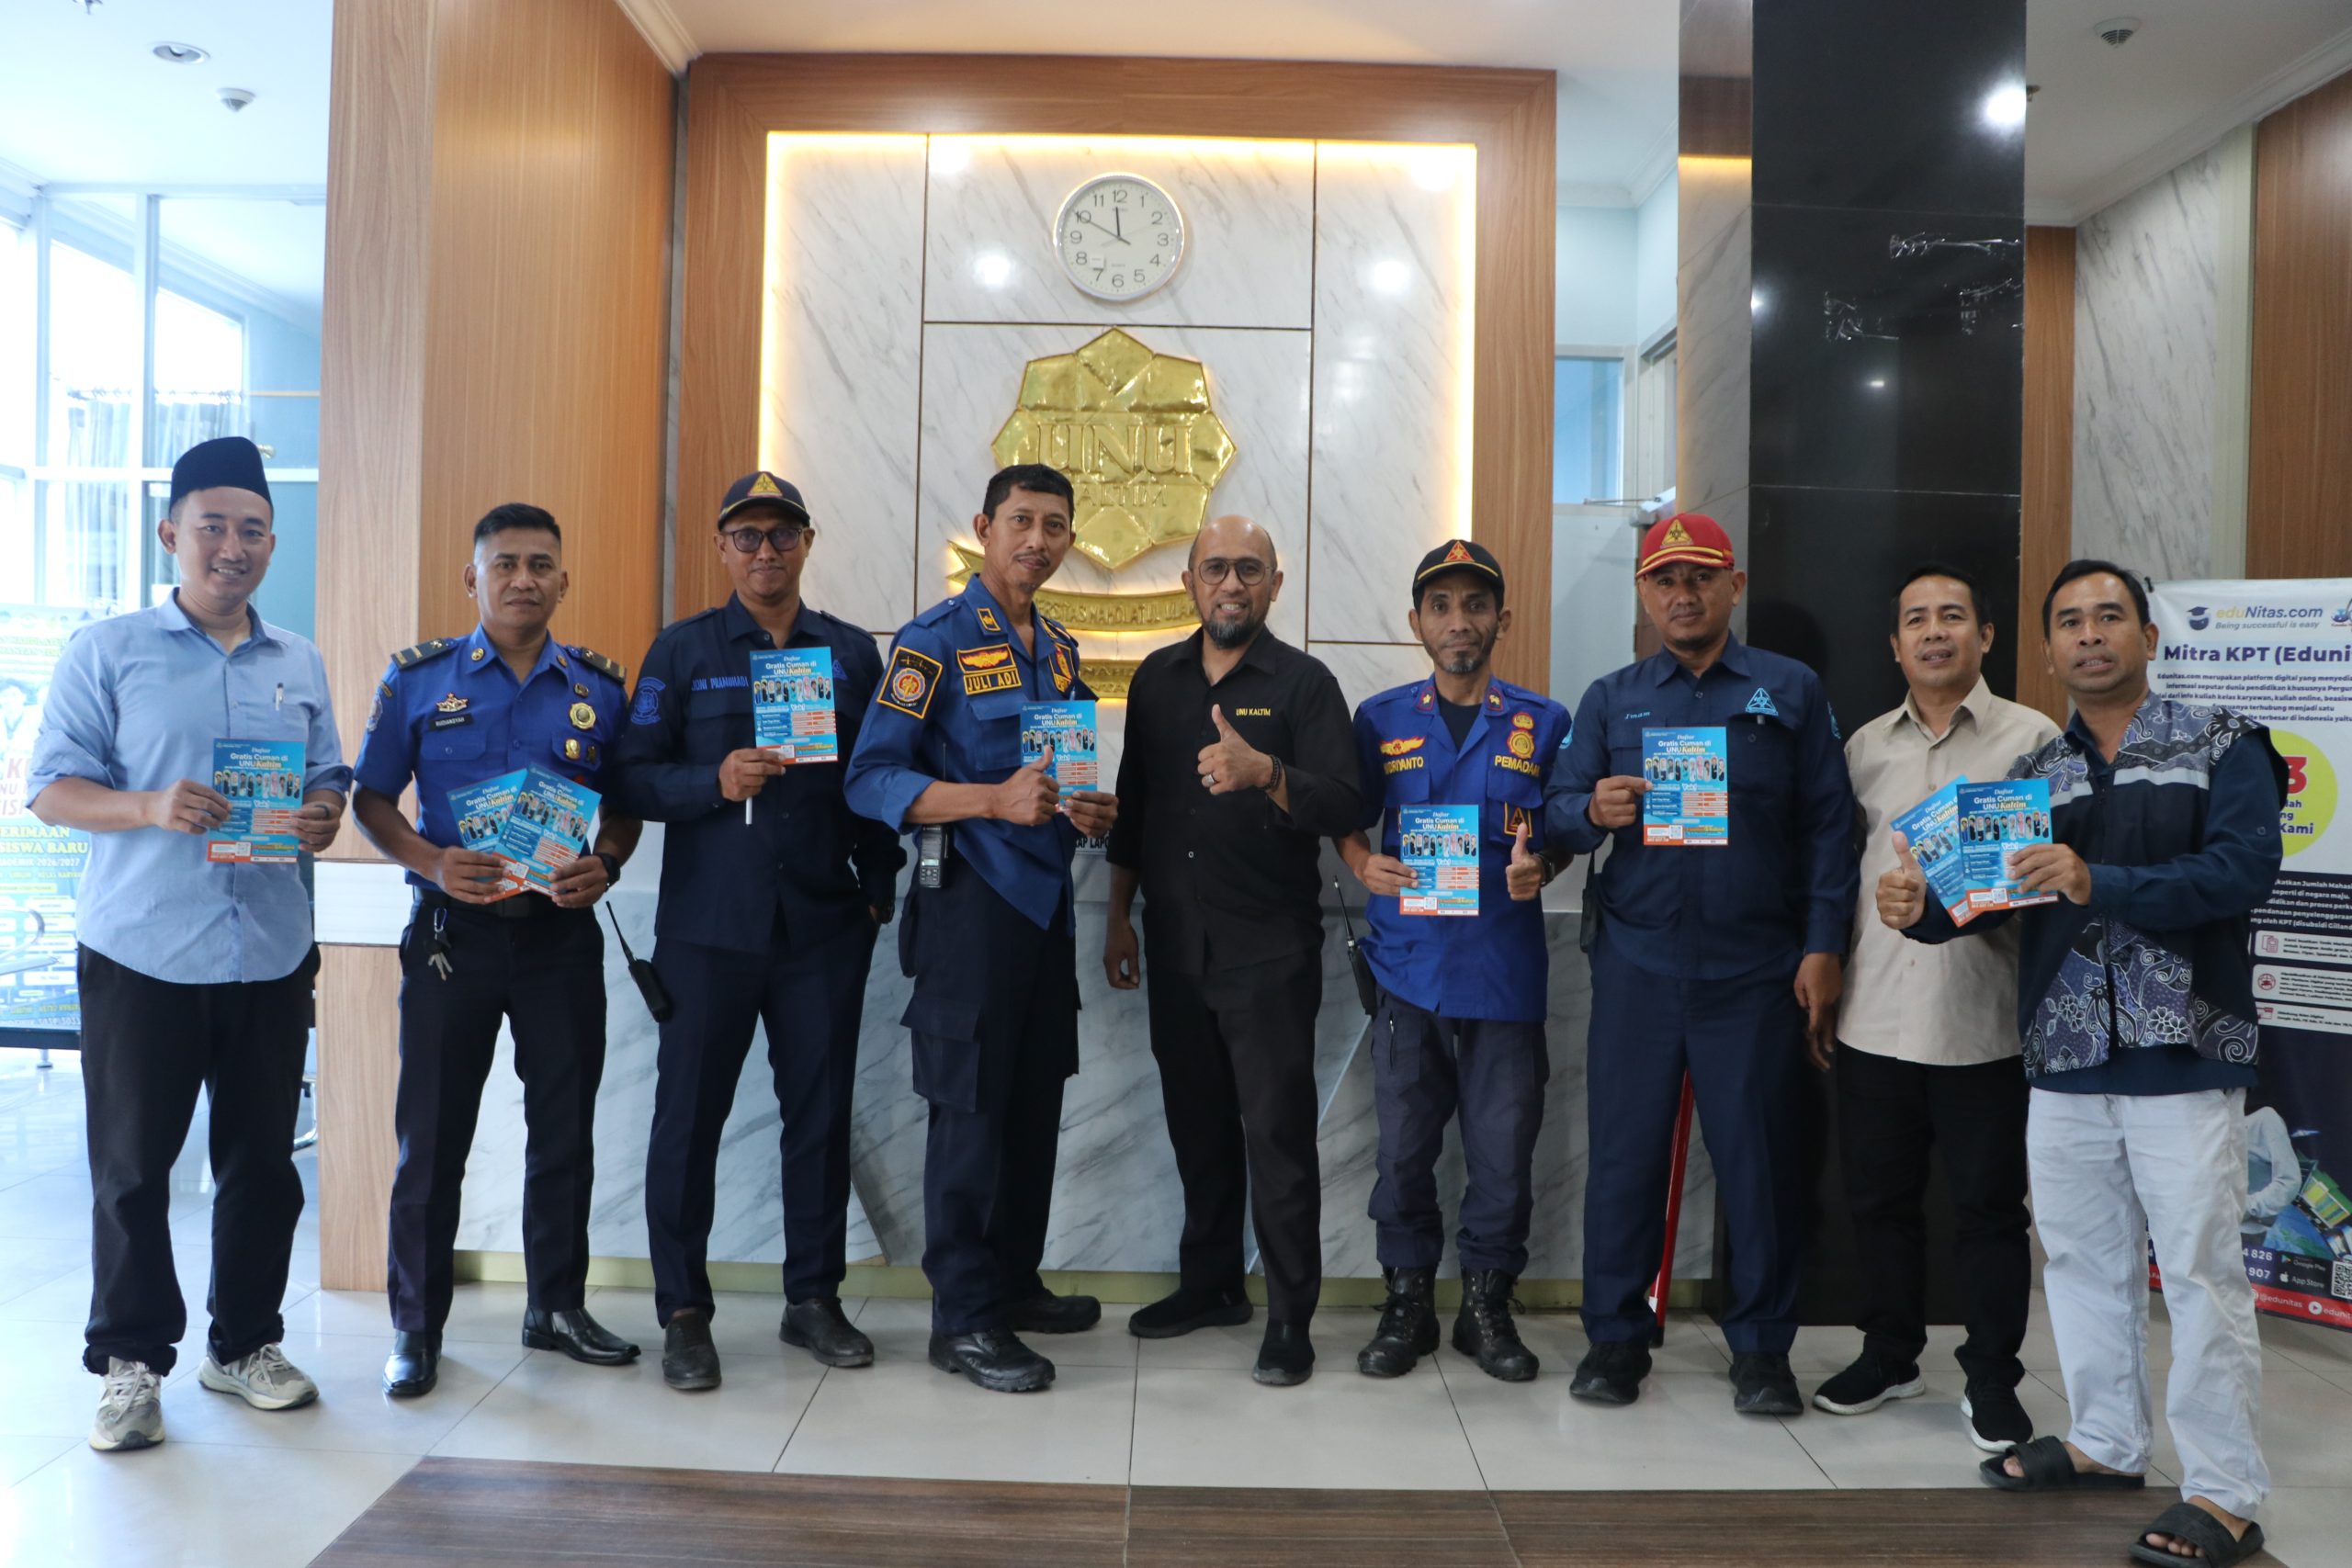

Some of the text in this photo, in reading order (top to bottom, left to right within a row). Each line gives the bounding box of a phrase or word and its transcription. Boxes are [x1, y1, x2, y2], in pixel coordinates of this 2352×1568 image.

[1093, 194, 1104, 207] 11
[1112, 189, 1128, 203] 12
[1075, 209, 1091, 224] 10
[1151, 211, 1163, 225] 2
[1069, 231, 1082, 244] 9
[1157, 232, 1170, 247] 3
[1075, 251, 1088, 265] 8
[1149, 254, 1160, 266] 4
[1092, 267, 1104, 282] 7
[1112, 274, 1125, 288] 6
[1134, 269, 1146, 283] 5
[1037, 423, 1192, 474] UNU
[1076, 484, 1167, 507] ALTIM
[2215, 605, 2324, 618] eduNitas.com
[2215, 621, 2241, 630] Being
[2242, 621, 2288, 629] successful
[2299, 621, 2320, 630] easy
[2164, 644, 2352, 665] Mitra KPT (Eduni
[967, 672, 1019, 692] JULI ADI
[1236, 708, 1271, 716] UNU KALTIM
[1973, 796, 1996, 805] Gratis
[1983, 802, 2000, 810] UNU
[2278, 823, 2313, 834] Kami
[47, 840, 89, 853] BARU
[2251, 1248, 2273, 1261] 826
[2248, 1267, 2270, 1279] 907
[2292, 1276, 2306, 1285] App
